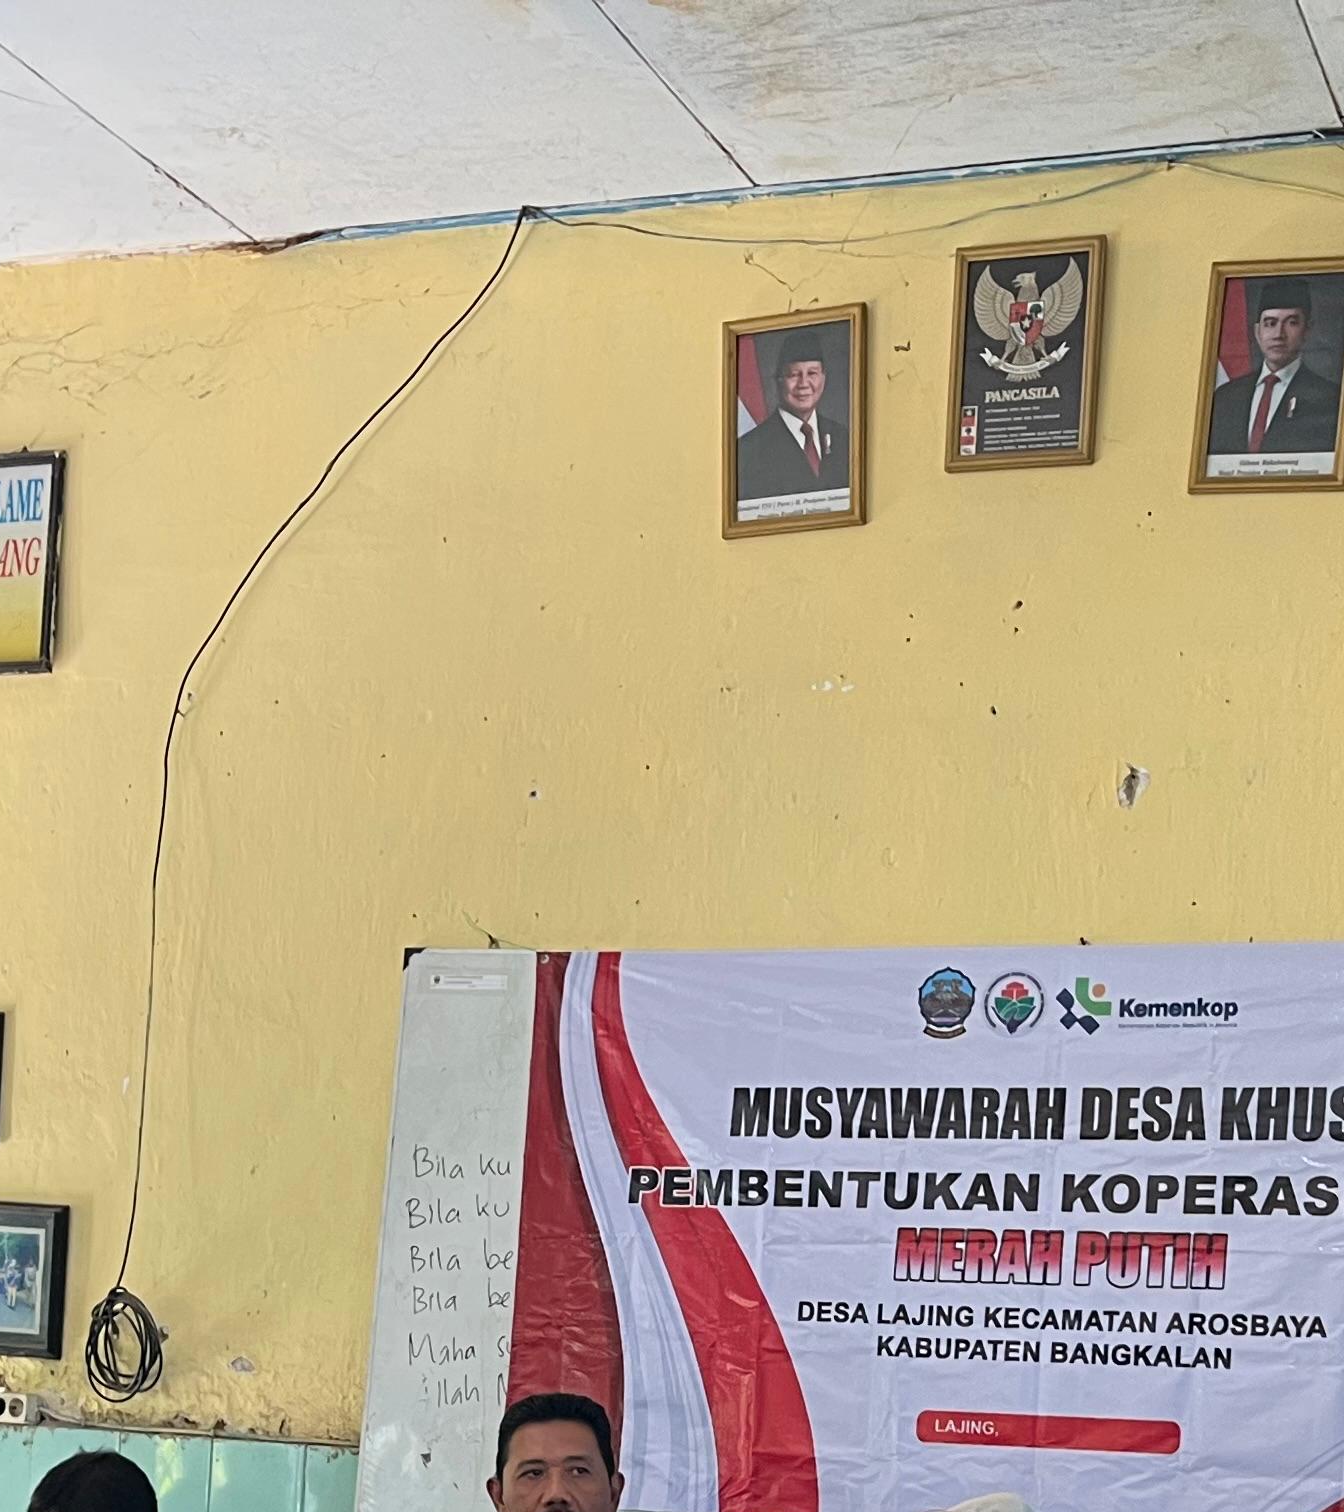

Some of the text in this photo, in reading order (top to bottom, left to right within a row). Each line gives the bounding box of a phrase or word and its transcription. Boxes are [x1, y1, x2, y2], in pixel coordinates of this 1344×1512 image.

[984, 386, 1060, 403] PANCASILA
[1118, 997, 1239, 1021] Kemenkop
[729, 1086, 1067, 1140] MUSYAWARAH
[1079, 1086, 1207, 1142] DESA
[413, 1144, 464, 1179] Bila
[627, 1166, 1040, 1213] PEMBENTUKAN
[406, 1197, 461, 1228] Bila
[410, 1245, 461, 1273] Bila
[893, 1227, 1228, 1290] MERAH PUTIH
[413, 1285, 457, 1315] Bila
[798, 1301, 1327, 1339] DESA LAJING KECAMATAN AROSBAYA
[409, 1332, 476, 1366] Maha
[876, 1335, 1232, 1370] KABUPATEN BANGKALAN
[934, 1418, 999, 1438] LAJING,
